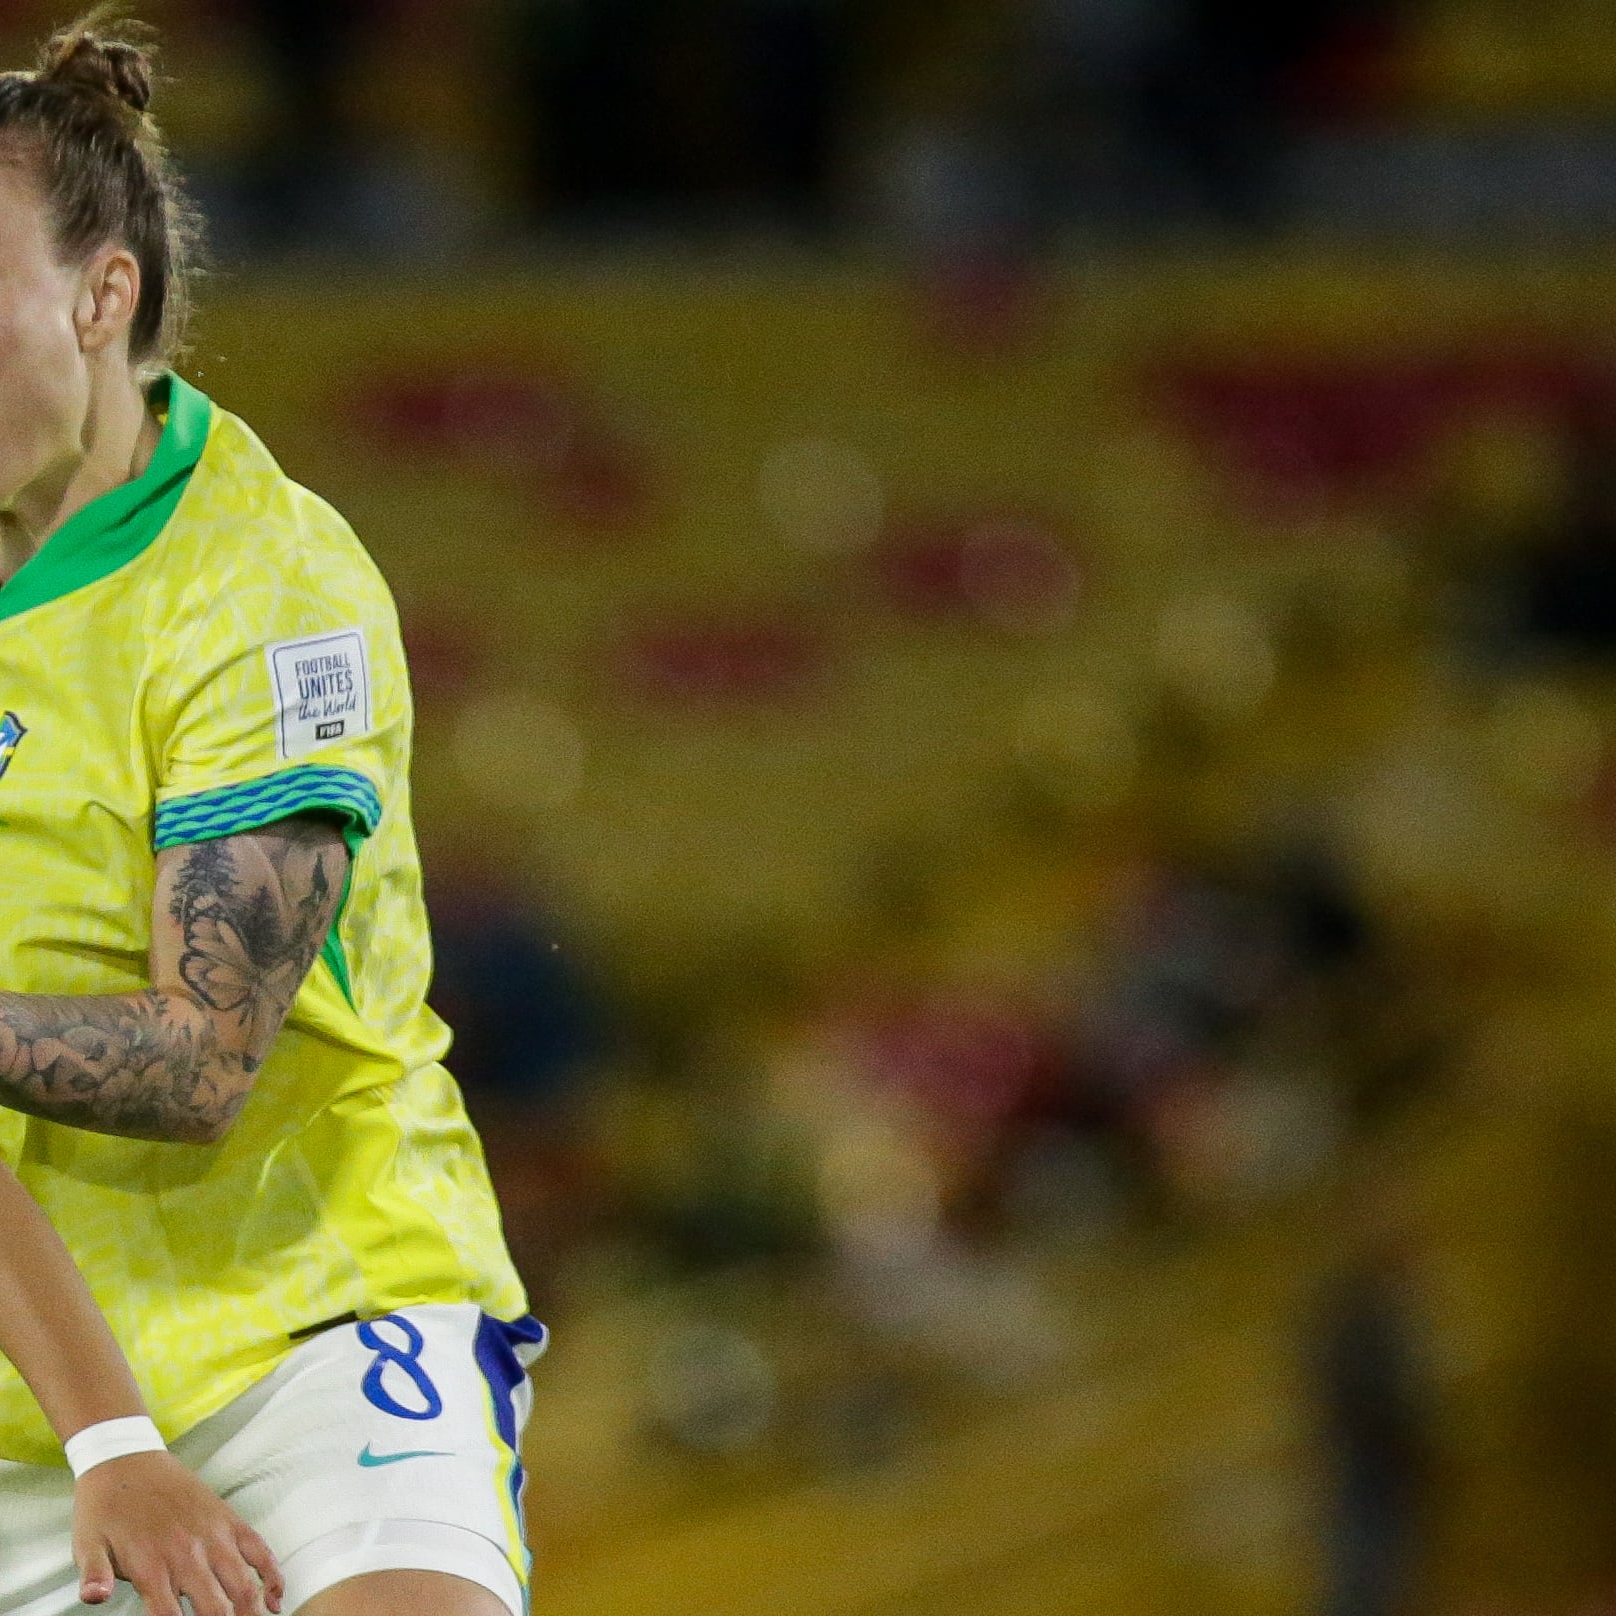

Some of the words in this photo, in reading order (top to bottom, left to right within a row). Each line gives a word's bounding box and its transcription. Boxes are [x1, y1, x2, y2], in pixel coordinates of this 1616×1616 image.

[295, 652, 351, 677] FOOTBALL
[298, 668, 353, 700] UNITES
[298, 700, 321, 720] the
[323, 692, 357, 718] World
[355, 1314, 443, 1421] 8
